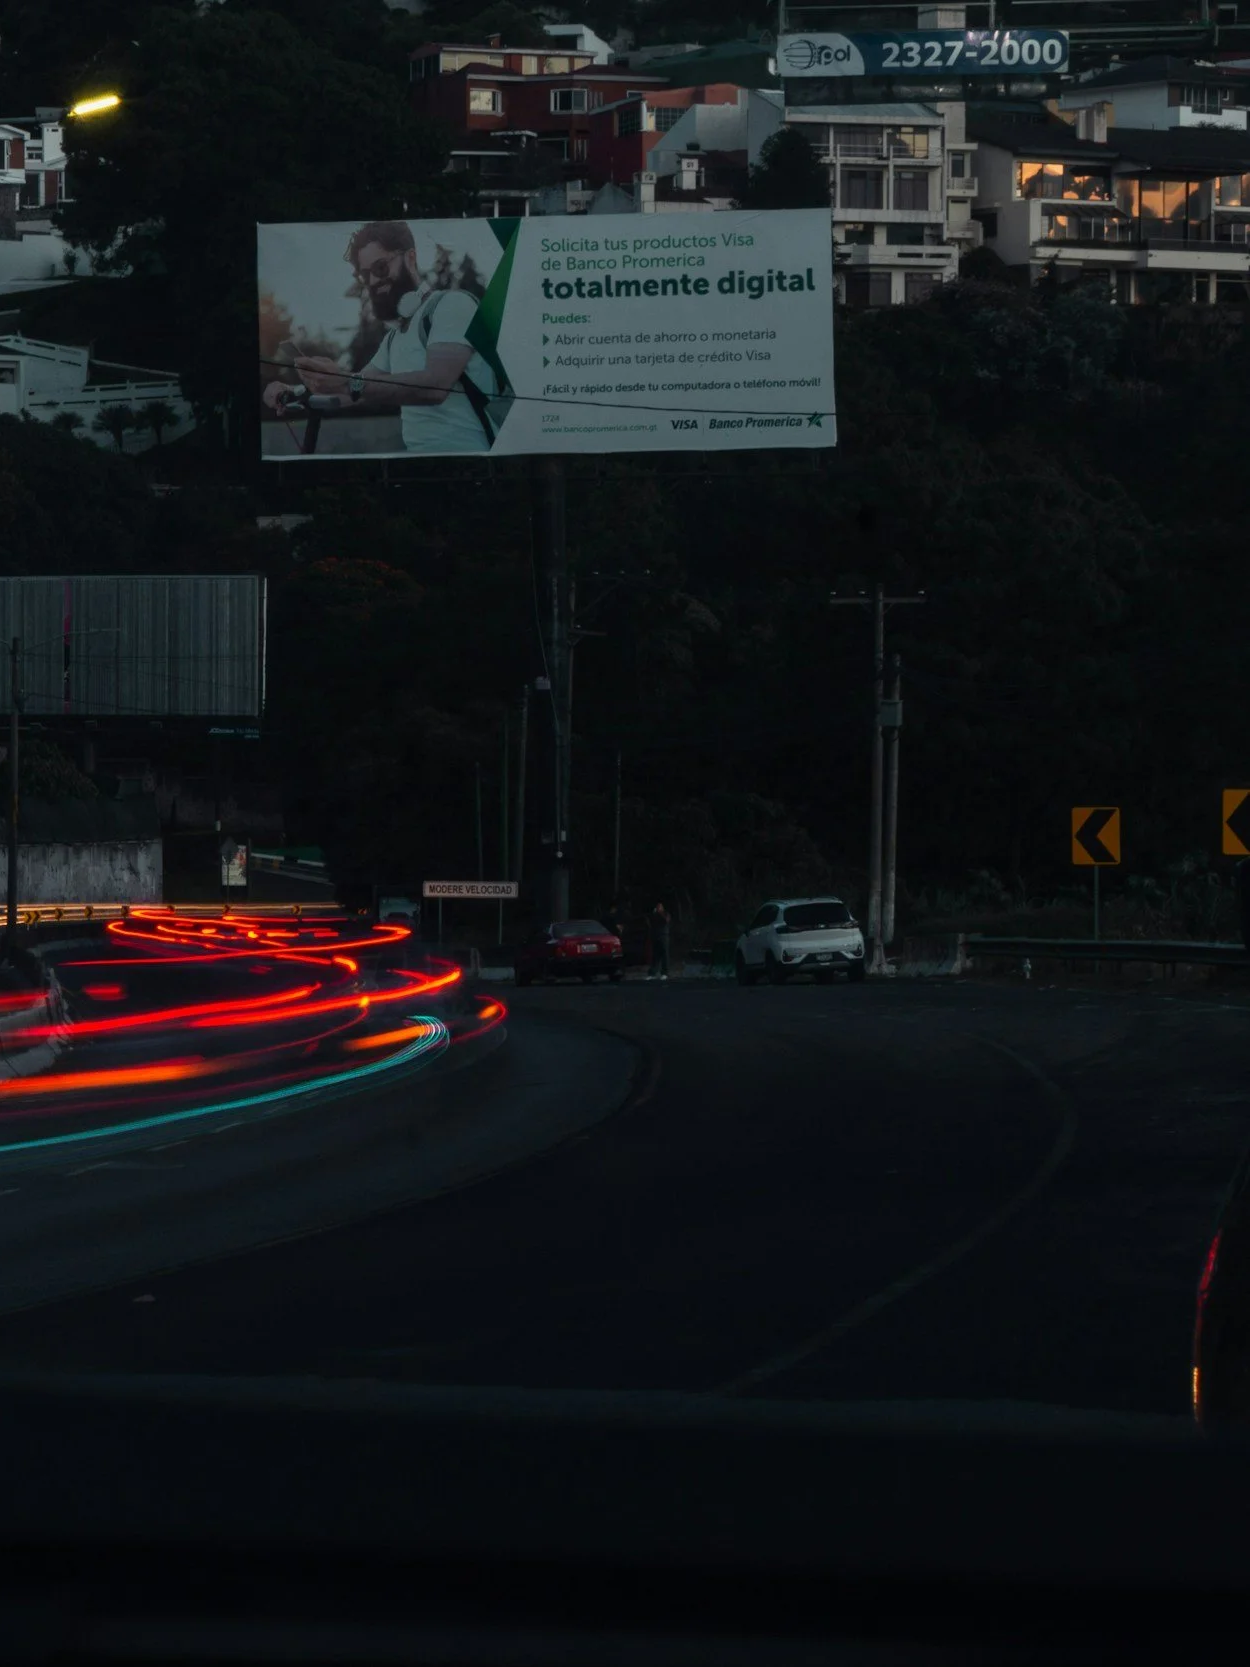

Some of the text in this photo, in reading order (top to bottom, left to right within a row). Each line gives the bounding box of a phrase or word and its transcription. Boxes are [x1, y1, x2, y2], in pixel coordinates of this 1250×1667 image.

[881, 38, 1063, 68] 2327-2000
[541, 232, 755, 253] Solicita tus productos Visa
[541, 252, 705, 271] de Banco Promerica
[541, 267, 816, 299] totalmente digital
[542, 312, 591, 324] Puedes:
[555, 328, 777, 345] Abrir cuenta de ahorro o monetaria
[555, 350, 771, 369] Adquirir una tarjeta de crédito Visa
[543, 377, 821, 396] ¡Fácil y rápido desde tu computadora o teléfono móvil!
[670, 416, 803, 430] VISA Banco Promerica
[428, 884, 513, 895] MODERE VELOCIDAD
